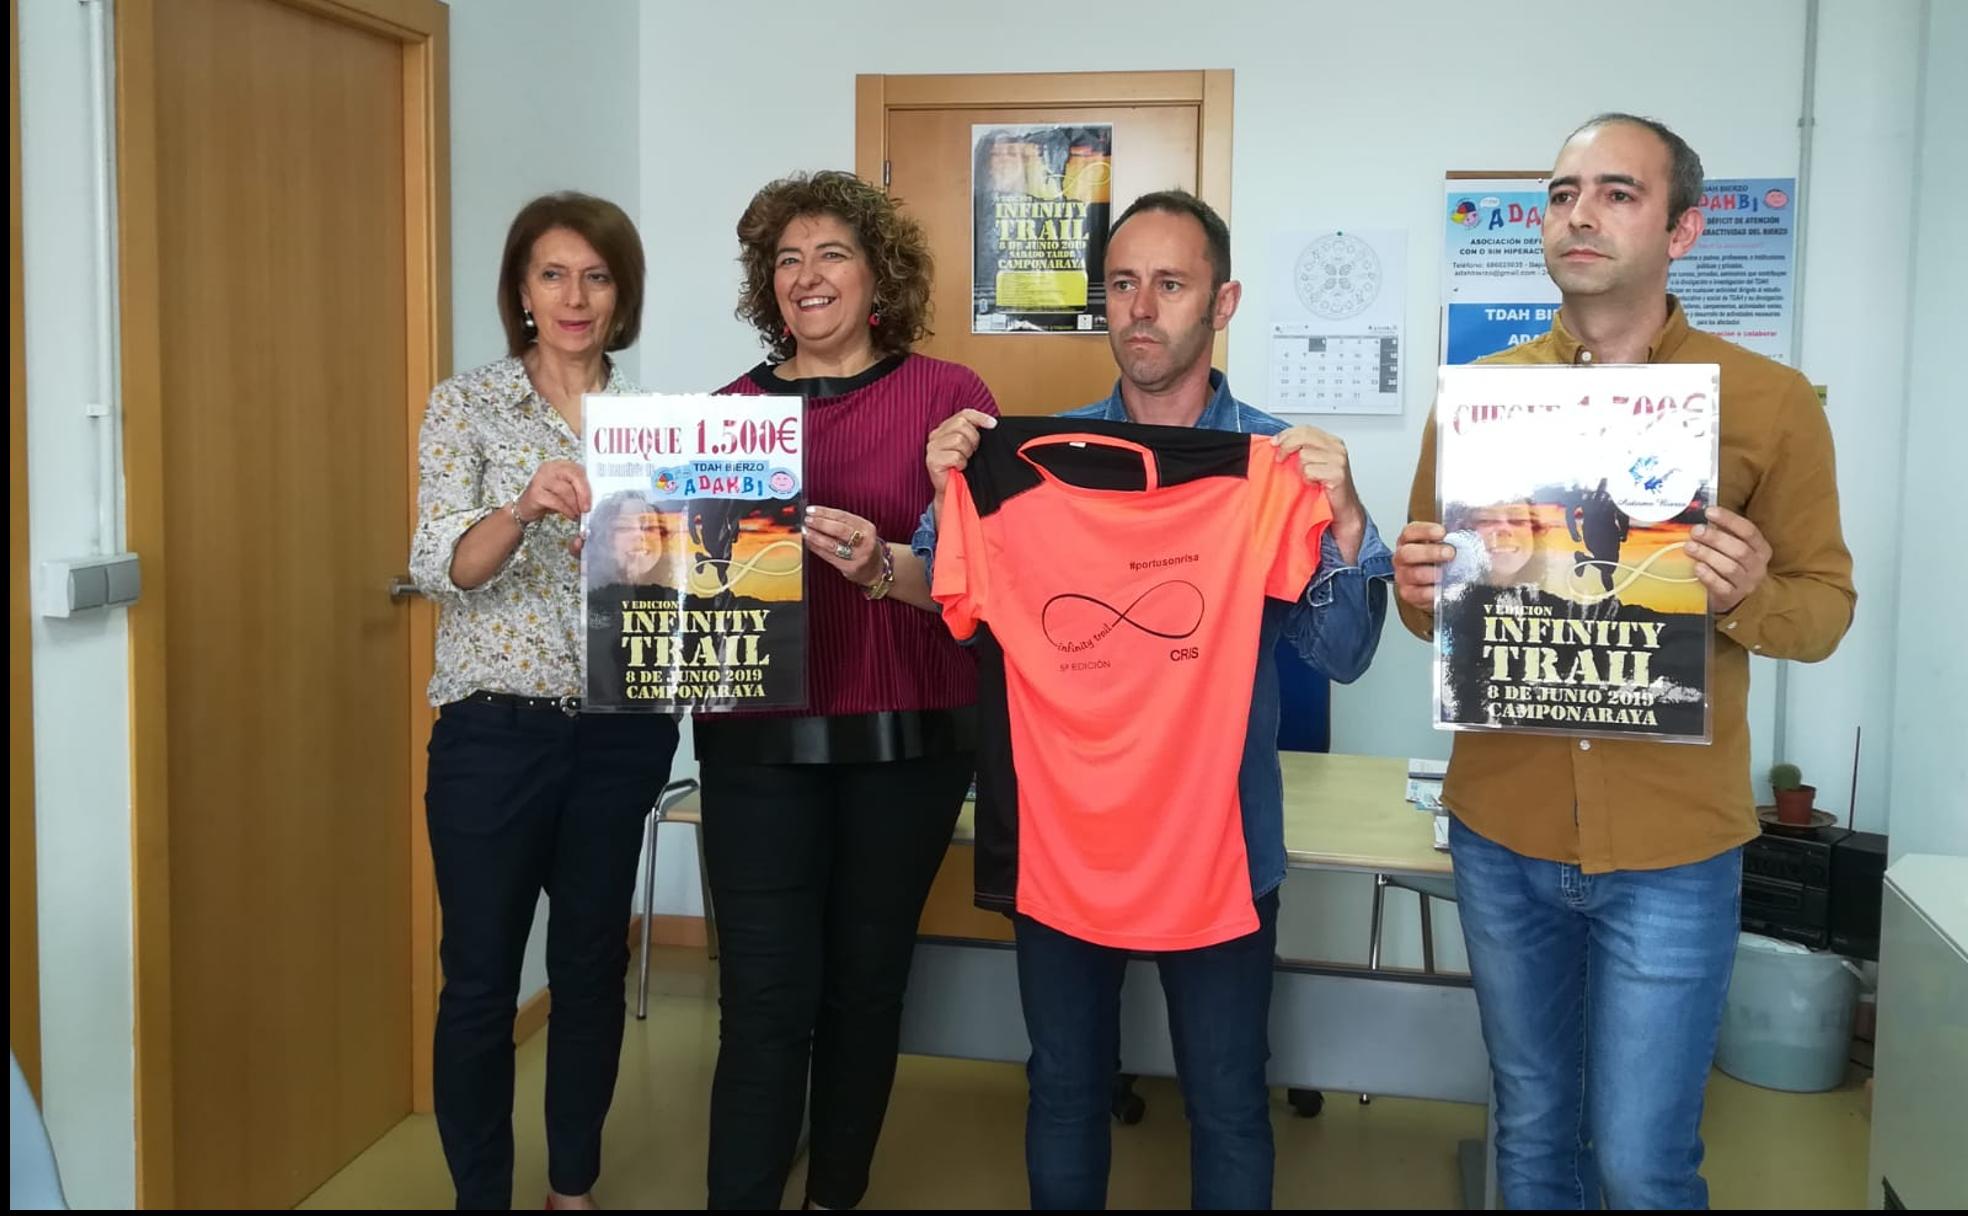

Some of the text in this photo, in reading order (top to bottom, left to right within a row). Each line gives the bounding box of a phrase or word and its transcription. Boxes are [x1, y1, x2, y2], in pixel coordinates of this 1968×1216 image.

[995, 202, 1087, 218] INFINITY
[1699, 194, 1758, 212] DAHBI
[1488, 203, 1543, 230] ADA
[996, 219, 1090, 240] TRAIL
[1008, 242, 1023, 250] DE
[1025, 242, 1059, 250] JUNIO
[998, 259, 1087, 269] CAMPONARAYA
[1484, 308, 1530, 320] TDAH
[594, 416, 798, 460] CHEQUE 1.500€
[694, 462, 722, 472] TDAH
[726, 462, 765, 472] BIERZO
[1130, 554, 1200, 571] #portusonrisa
[622, 600, 679, 610] V EDICION
[1483, 604, 1493, 614] V
[620, 610, 771, 634] INFINITY
[1483, 616, 1667, 648] INFINITY
[620, 635, 770, 667] TRAIL
[1058, 639, 1094, 652] infinity
[625, 669, 763, 684] 8 DE JUNIO 2019
[626, 684, 766, 699] CAMPONARAYA
[1488, 685, 1654, 707] 8 DE JUNIO 2019
[1488, 702, 1658, 726] CAMPONARAYA
